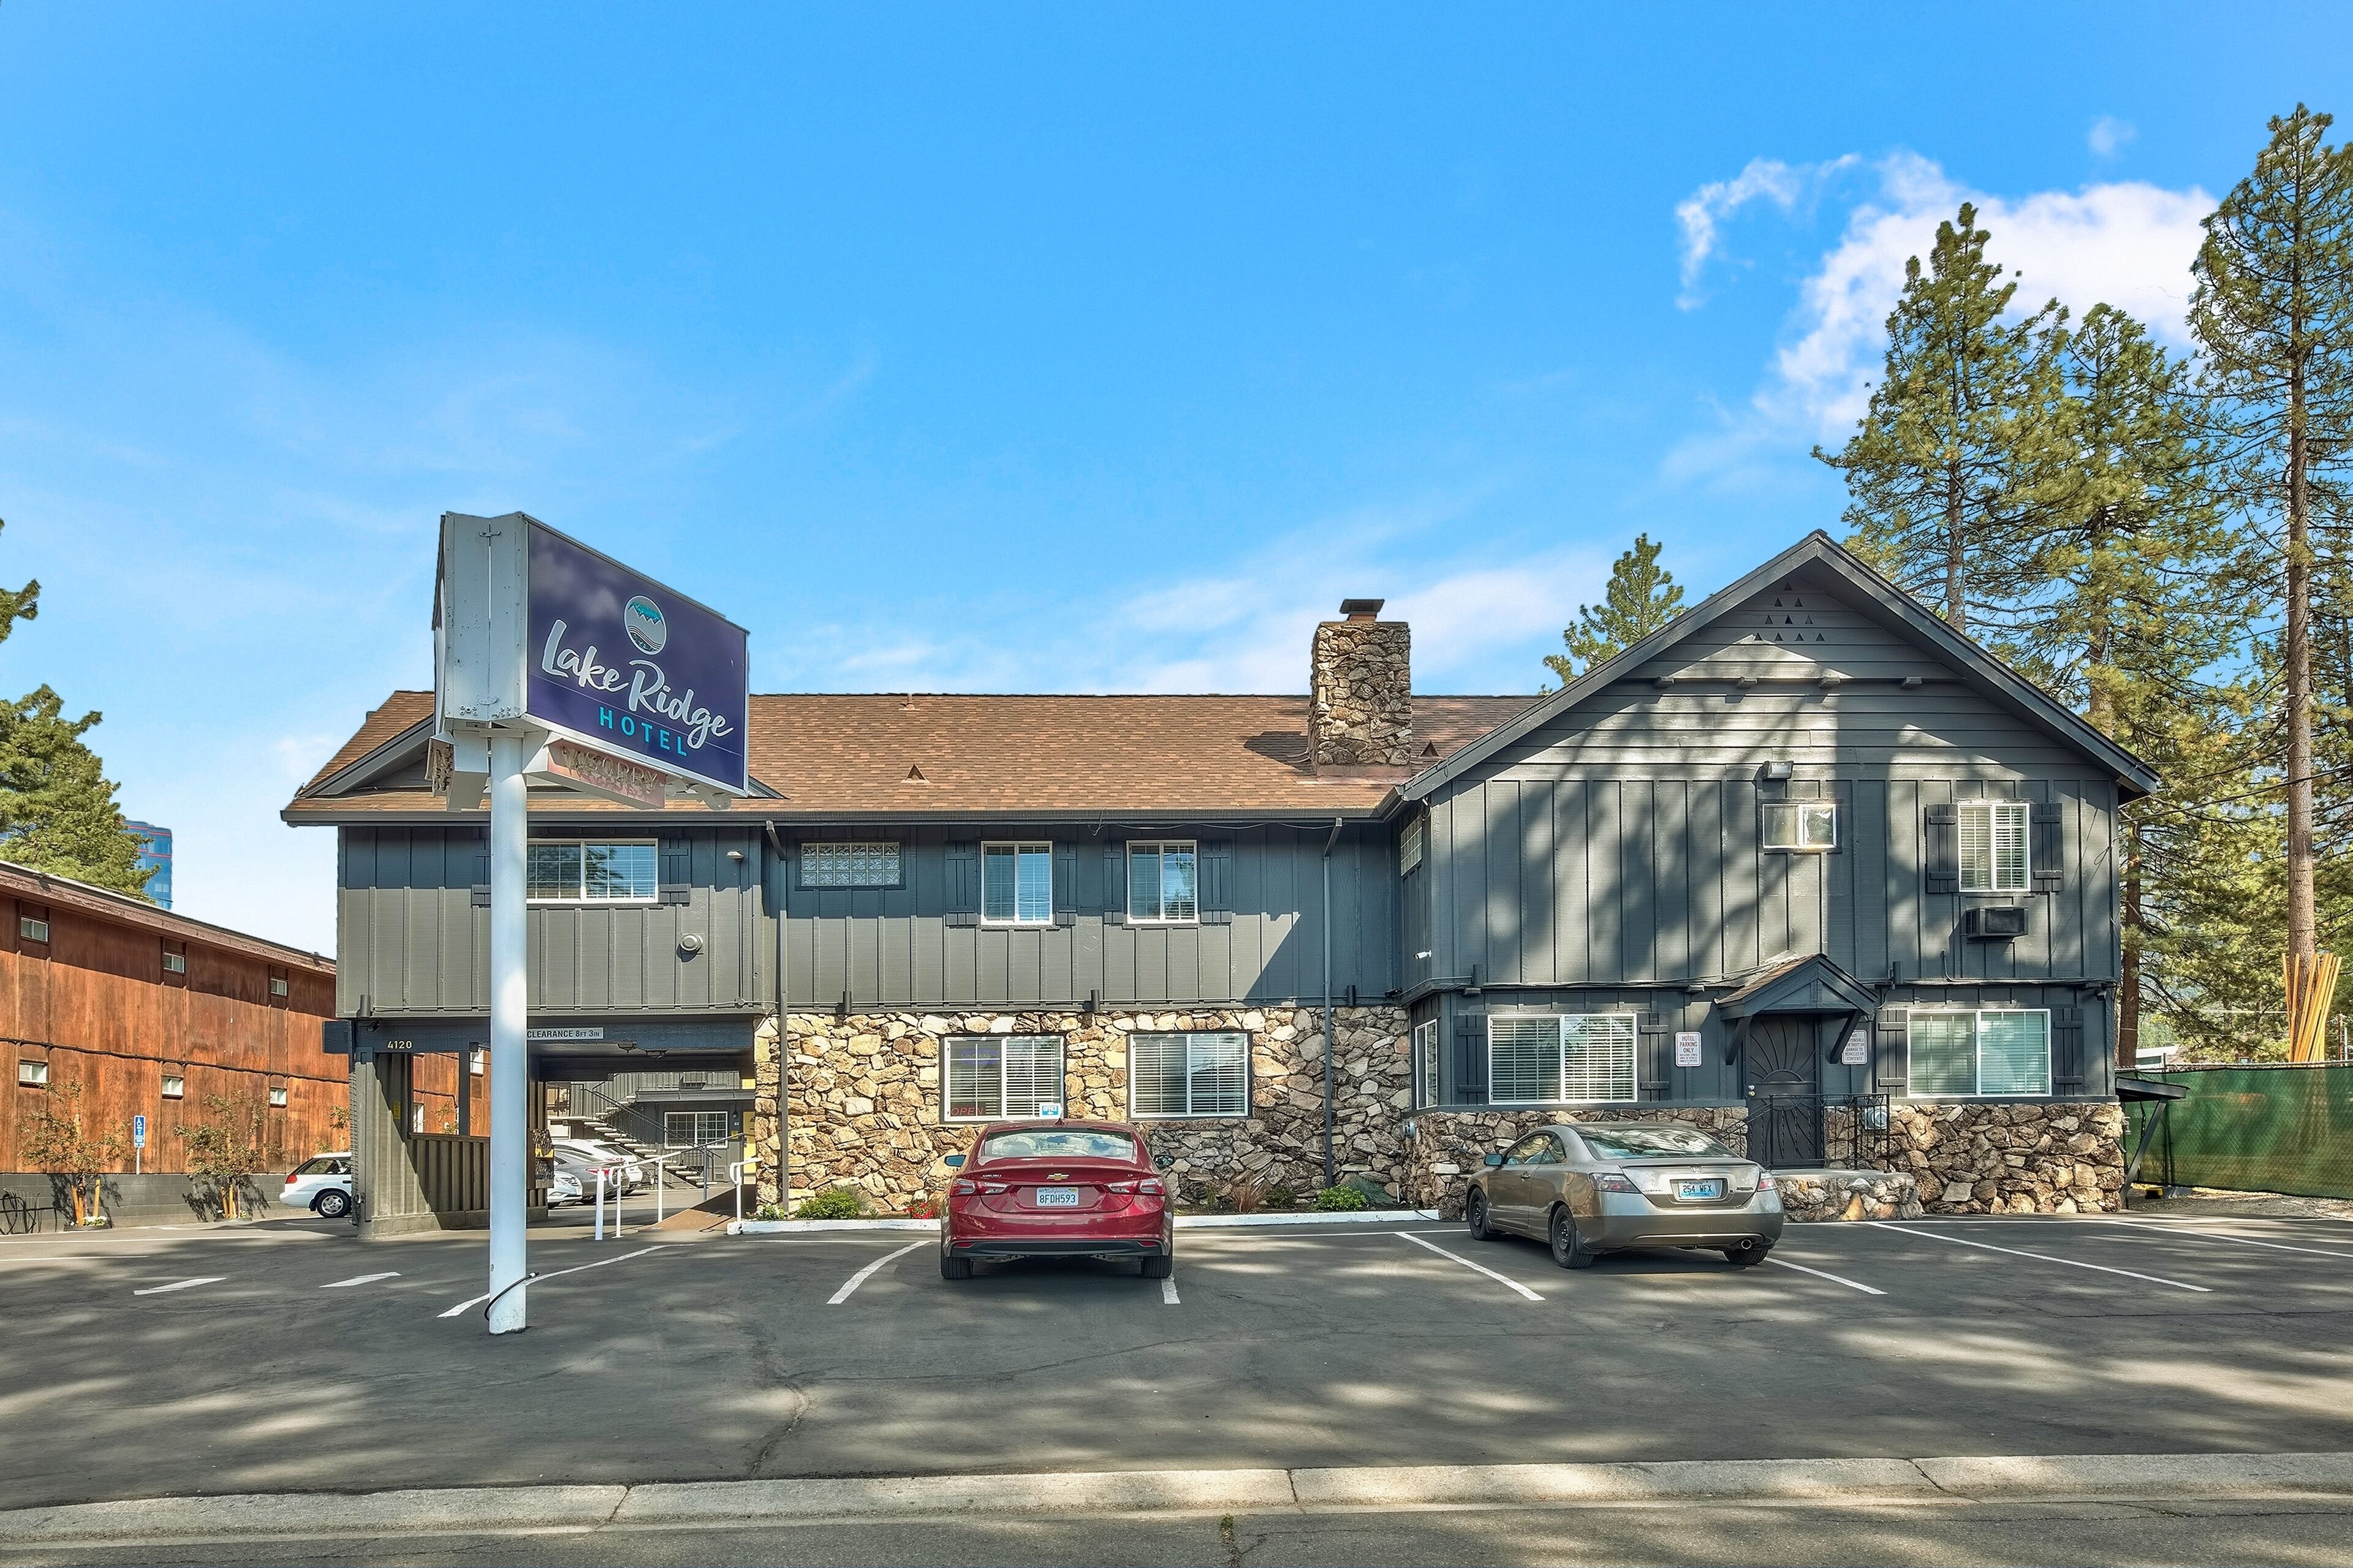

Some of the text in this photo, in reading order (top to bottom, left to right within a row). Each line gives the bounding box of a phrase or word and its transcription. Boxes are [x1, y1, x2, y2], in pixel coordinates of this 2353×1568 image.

[542, 618, 734, 749] Lake Ridge
[599, 706, 688, 757] HOTEL
[527, 1030, 573, 1039] CLEARANCE
[387, 1040, 412, 1049] 4120
[951, 1107, 983, 1116] OPEN
[1039, 1194, 1076, 1203] 8FDH593
